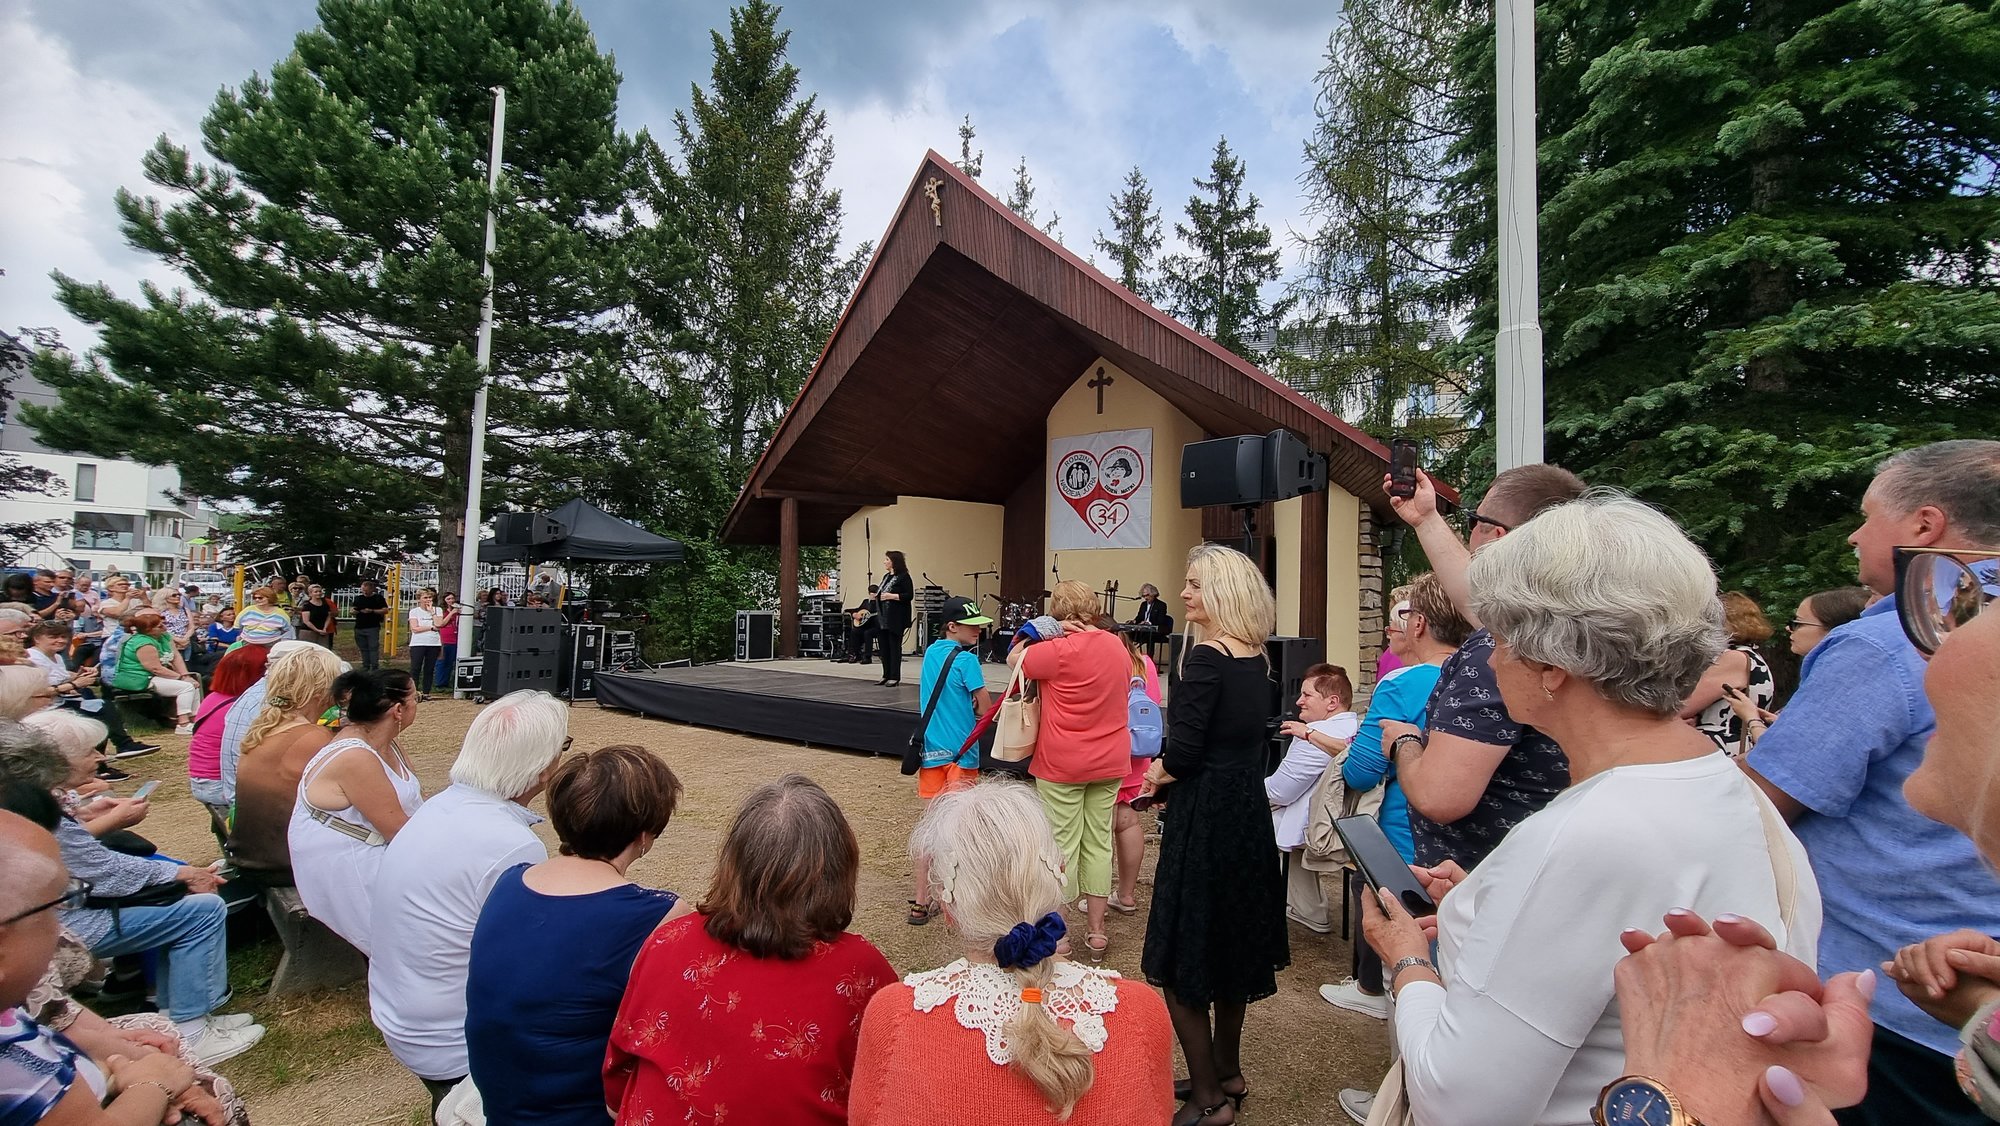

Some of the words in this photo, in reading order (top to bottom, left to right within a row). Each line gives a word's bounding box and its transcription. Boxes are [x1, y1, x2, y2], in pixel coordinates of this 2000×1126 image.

[1064, 455, 1093, 467] RODZINA
[1083, 476, 1096, 495] JUTRA
[1121, 483, 1135, 494] MATKI
[1098, 508, 1117, 526] 34
